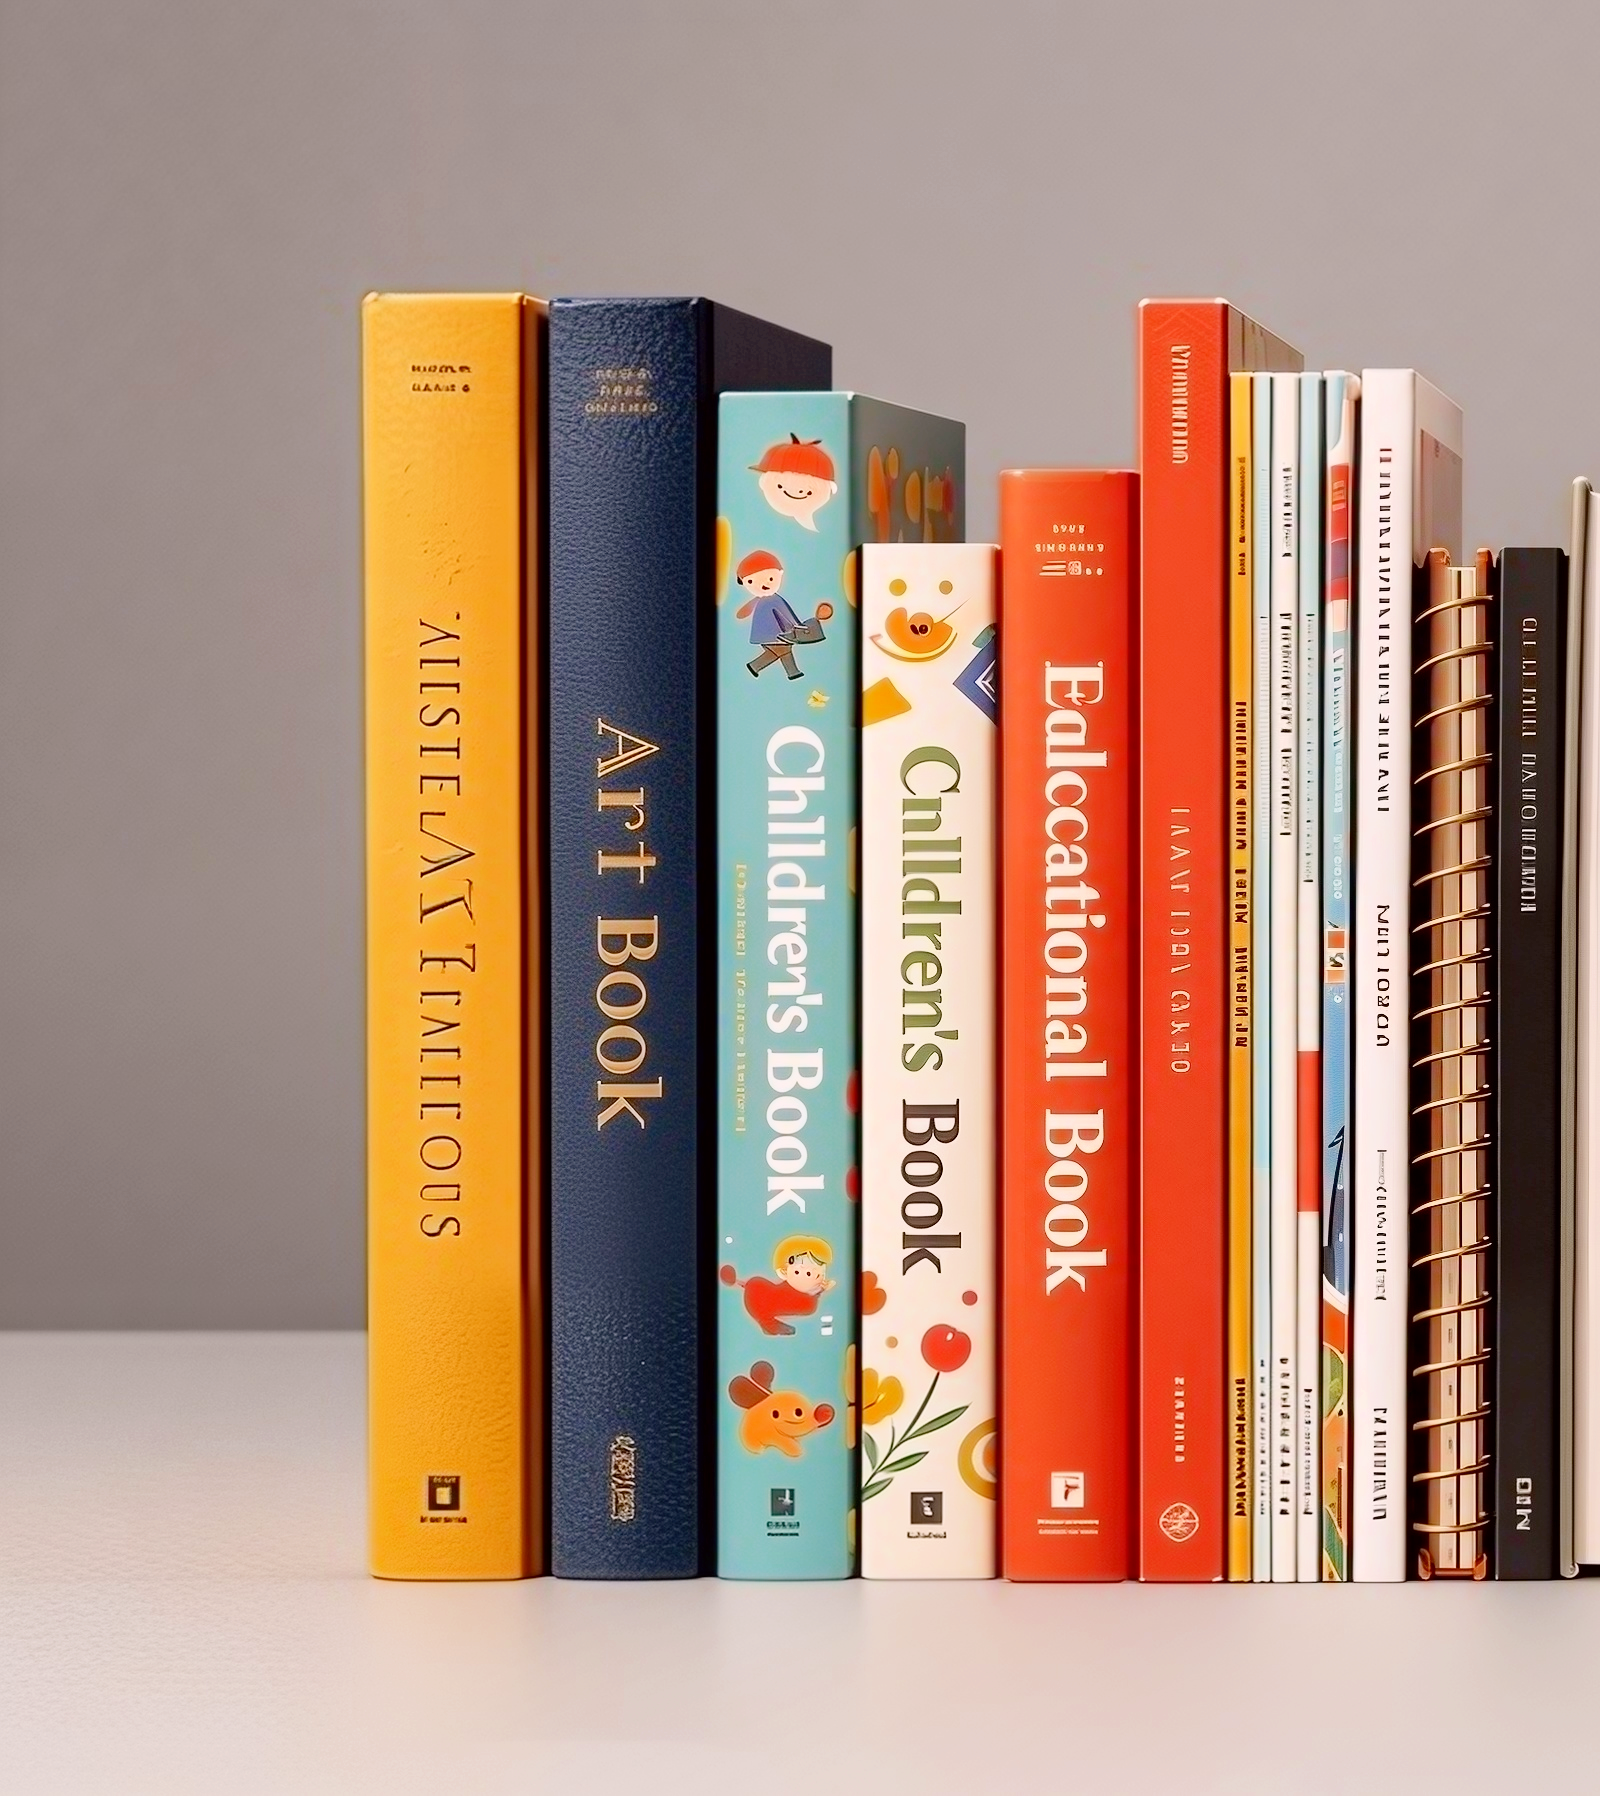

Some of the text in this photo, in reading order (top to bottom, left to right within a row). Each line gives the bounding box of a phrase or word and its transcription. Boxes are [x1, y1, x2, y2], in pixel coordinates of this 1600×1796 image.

[595, 718, 664, 1131] Art Book
[767, 1048, 825, 1215] Book
[901, 1098, 961, 1276] Book
[1044, 1108, 1108, 1296] Book
